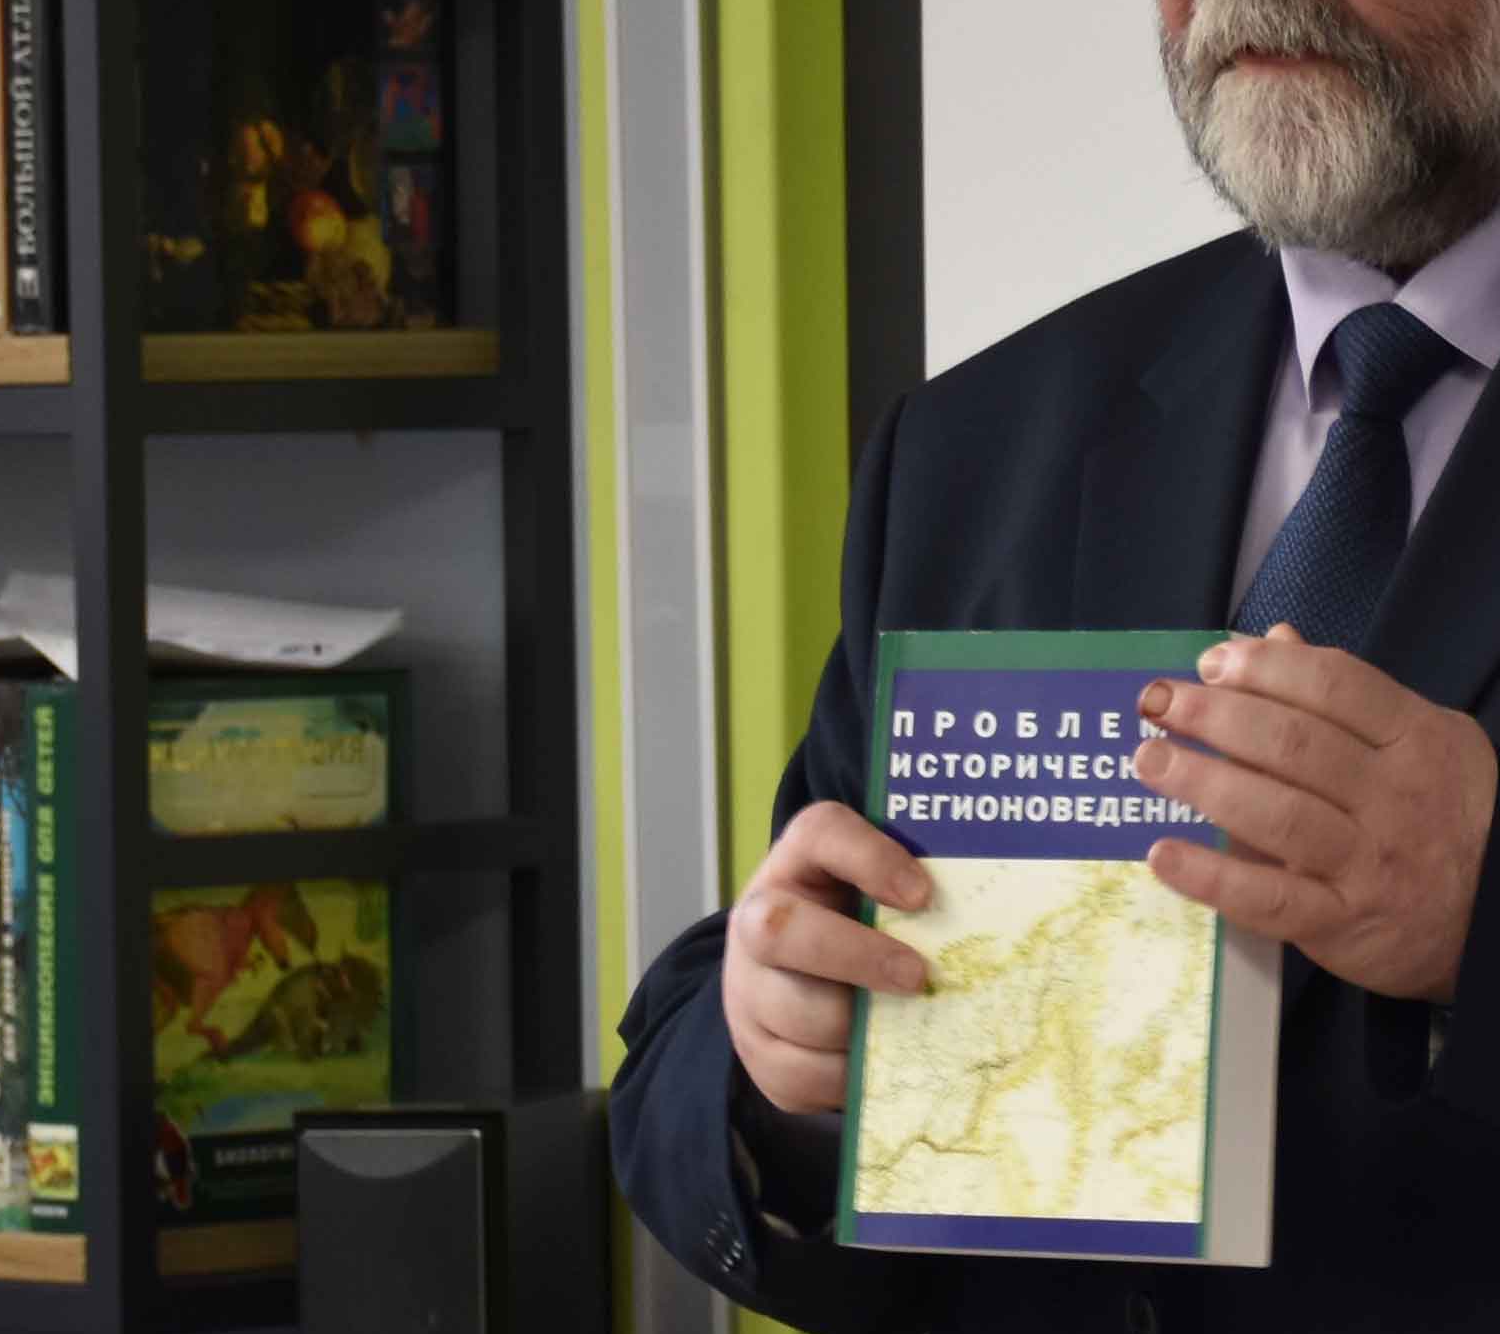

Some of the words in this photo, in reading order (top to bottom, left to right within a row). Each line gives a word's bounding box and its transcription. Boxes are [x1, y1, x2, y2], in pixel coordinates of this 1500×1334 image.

[7, 76, 37, 256] БОЛЬШОЙ
[31, 705, 55, 796] ДЕТЕЙ
[36, 804, 55, 864] ДЛЯ
[35, 872, 58, 1108] ЭНЦИКЛОПЕДИЯ
